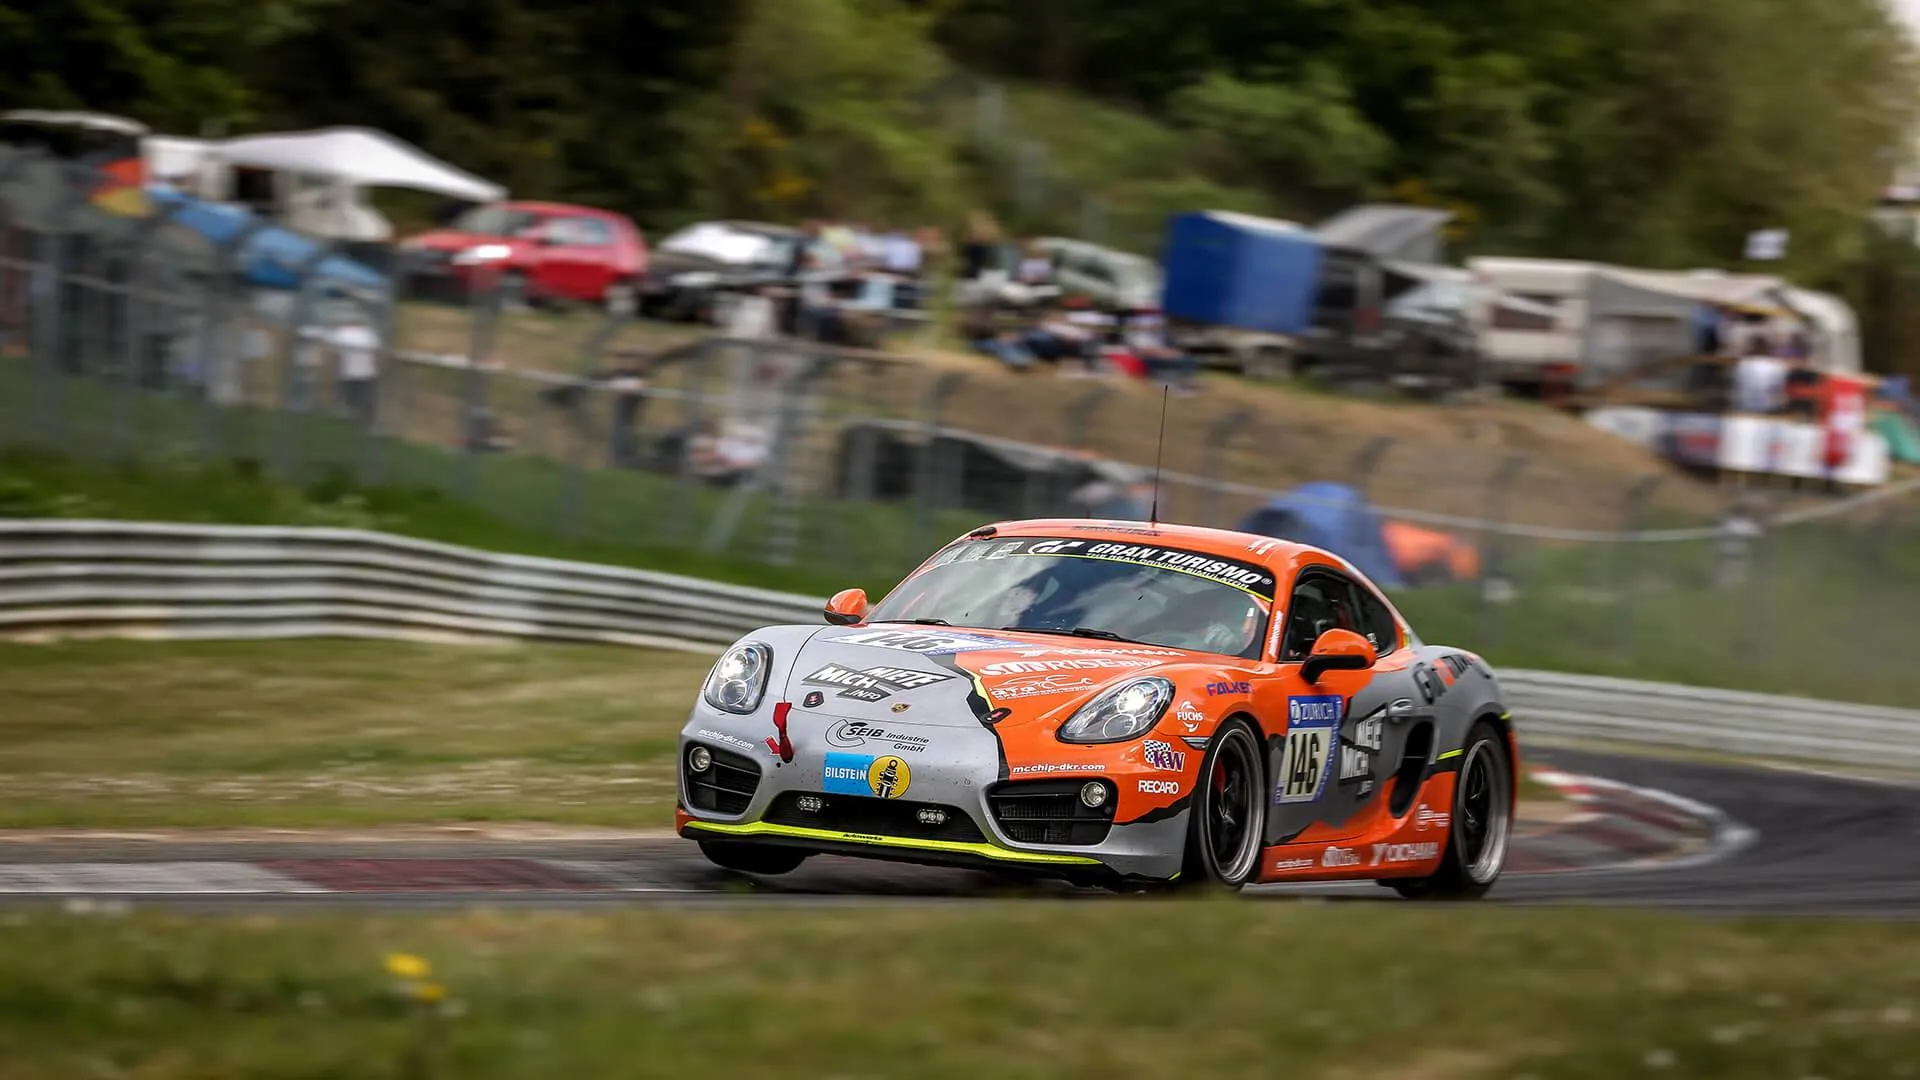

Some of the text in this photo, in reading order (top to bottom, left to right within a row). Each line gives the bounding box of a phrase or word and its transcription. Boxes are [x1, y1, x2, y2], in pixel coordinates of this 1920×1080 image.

[1088, 543, 1263, 584] GRAN TURISMO
[858, 633, 955, 650] 146
[810, 665, 880, 690] MICH
[1177, 711, 1204, 721] FUCHS
[846, 727, 930, 744] SEIB Industrie
[893, 742, 926, 753] GmbH
[1012, 763, 1106, 774] mcchip-dkr.com
[1152, 749, 1186, 772] KW
[1284, 732, 1321, 796] 146
[824, 766, 867, 781] BILSTEIN
[1138, 780, 1180, 795] RECARO
